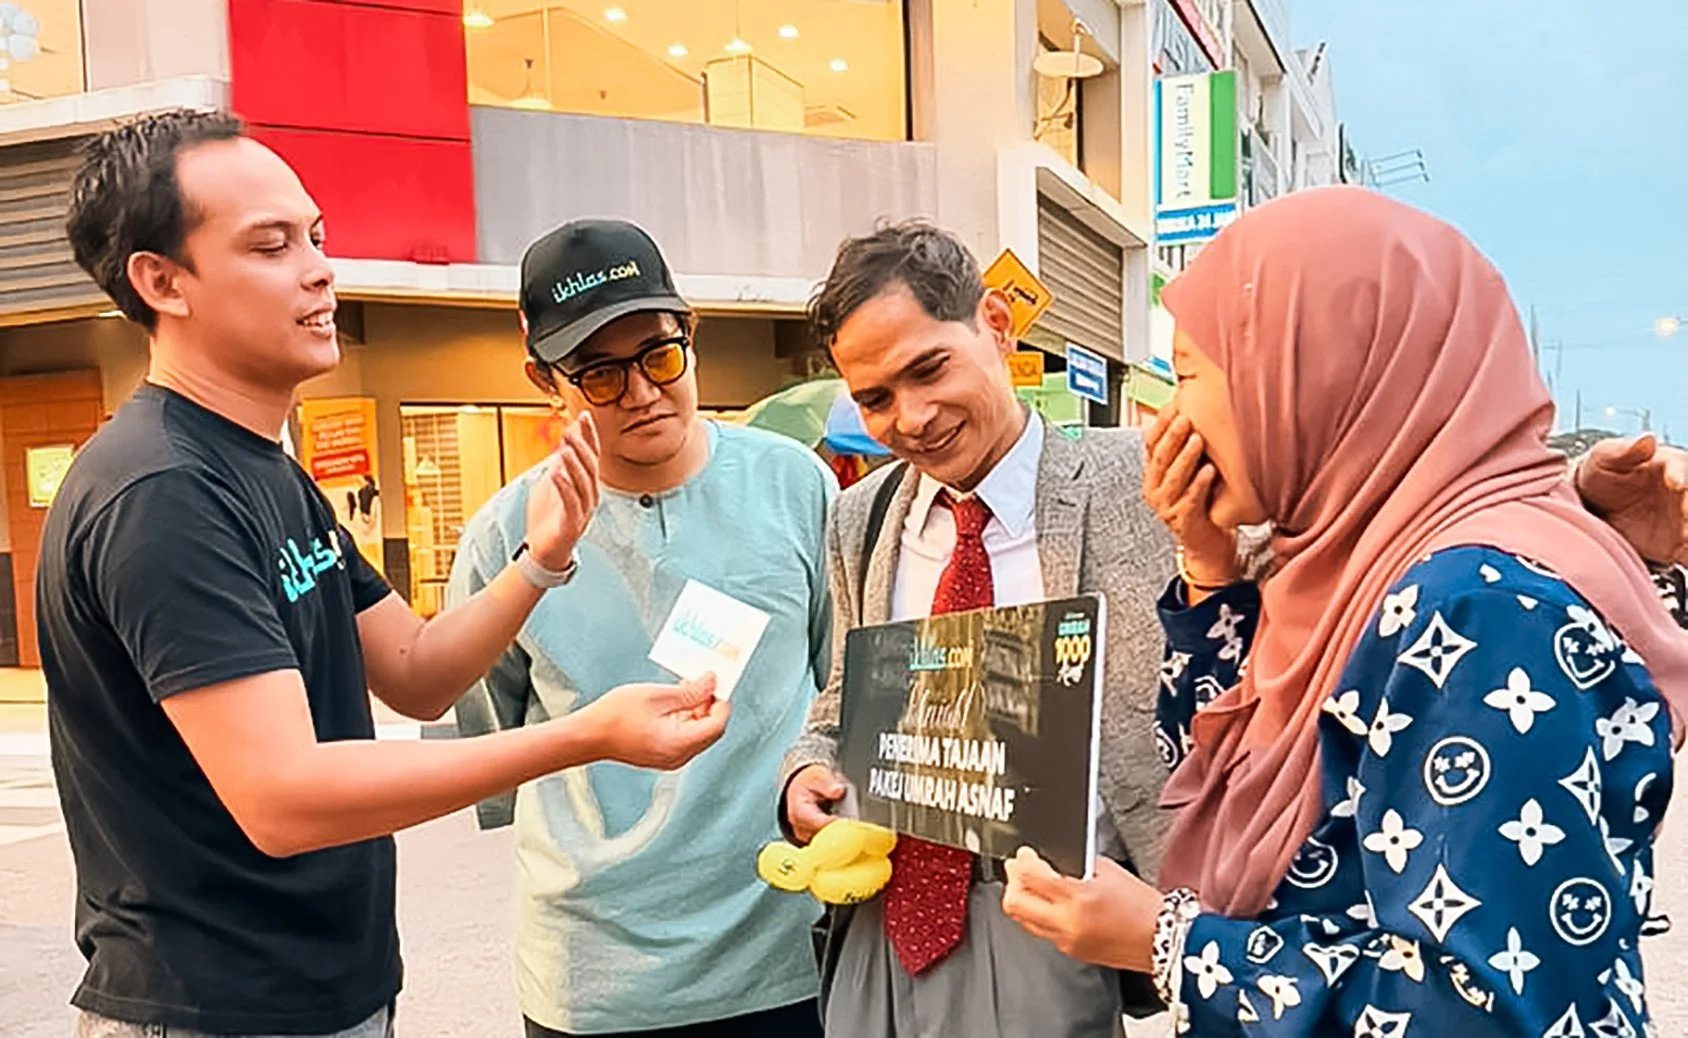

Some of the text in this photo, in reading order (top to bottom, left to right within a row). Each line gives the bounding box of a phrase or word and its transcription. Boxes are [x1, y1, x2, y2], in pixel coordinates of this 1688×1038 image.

[1174, 83, 1195, 199] FamilyMart
[878, 732, 1006, 776] PENERIMA TAJAAN
[868, 767, 1015, 822] PAKEJ UMRAH ASNAF
